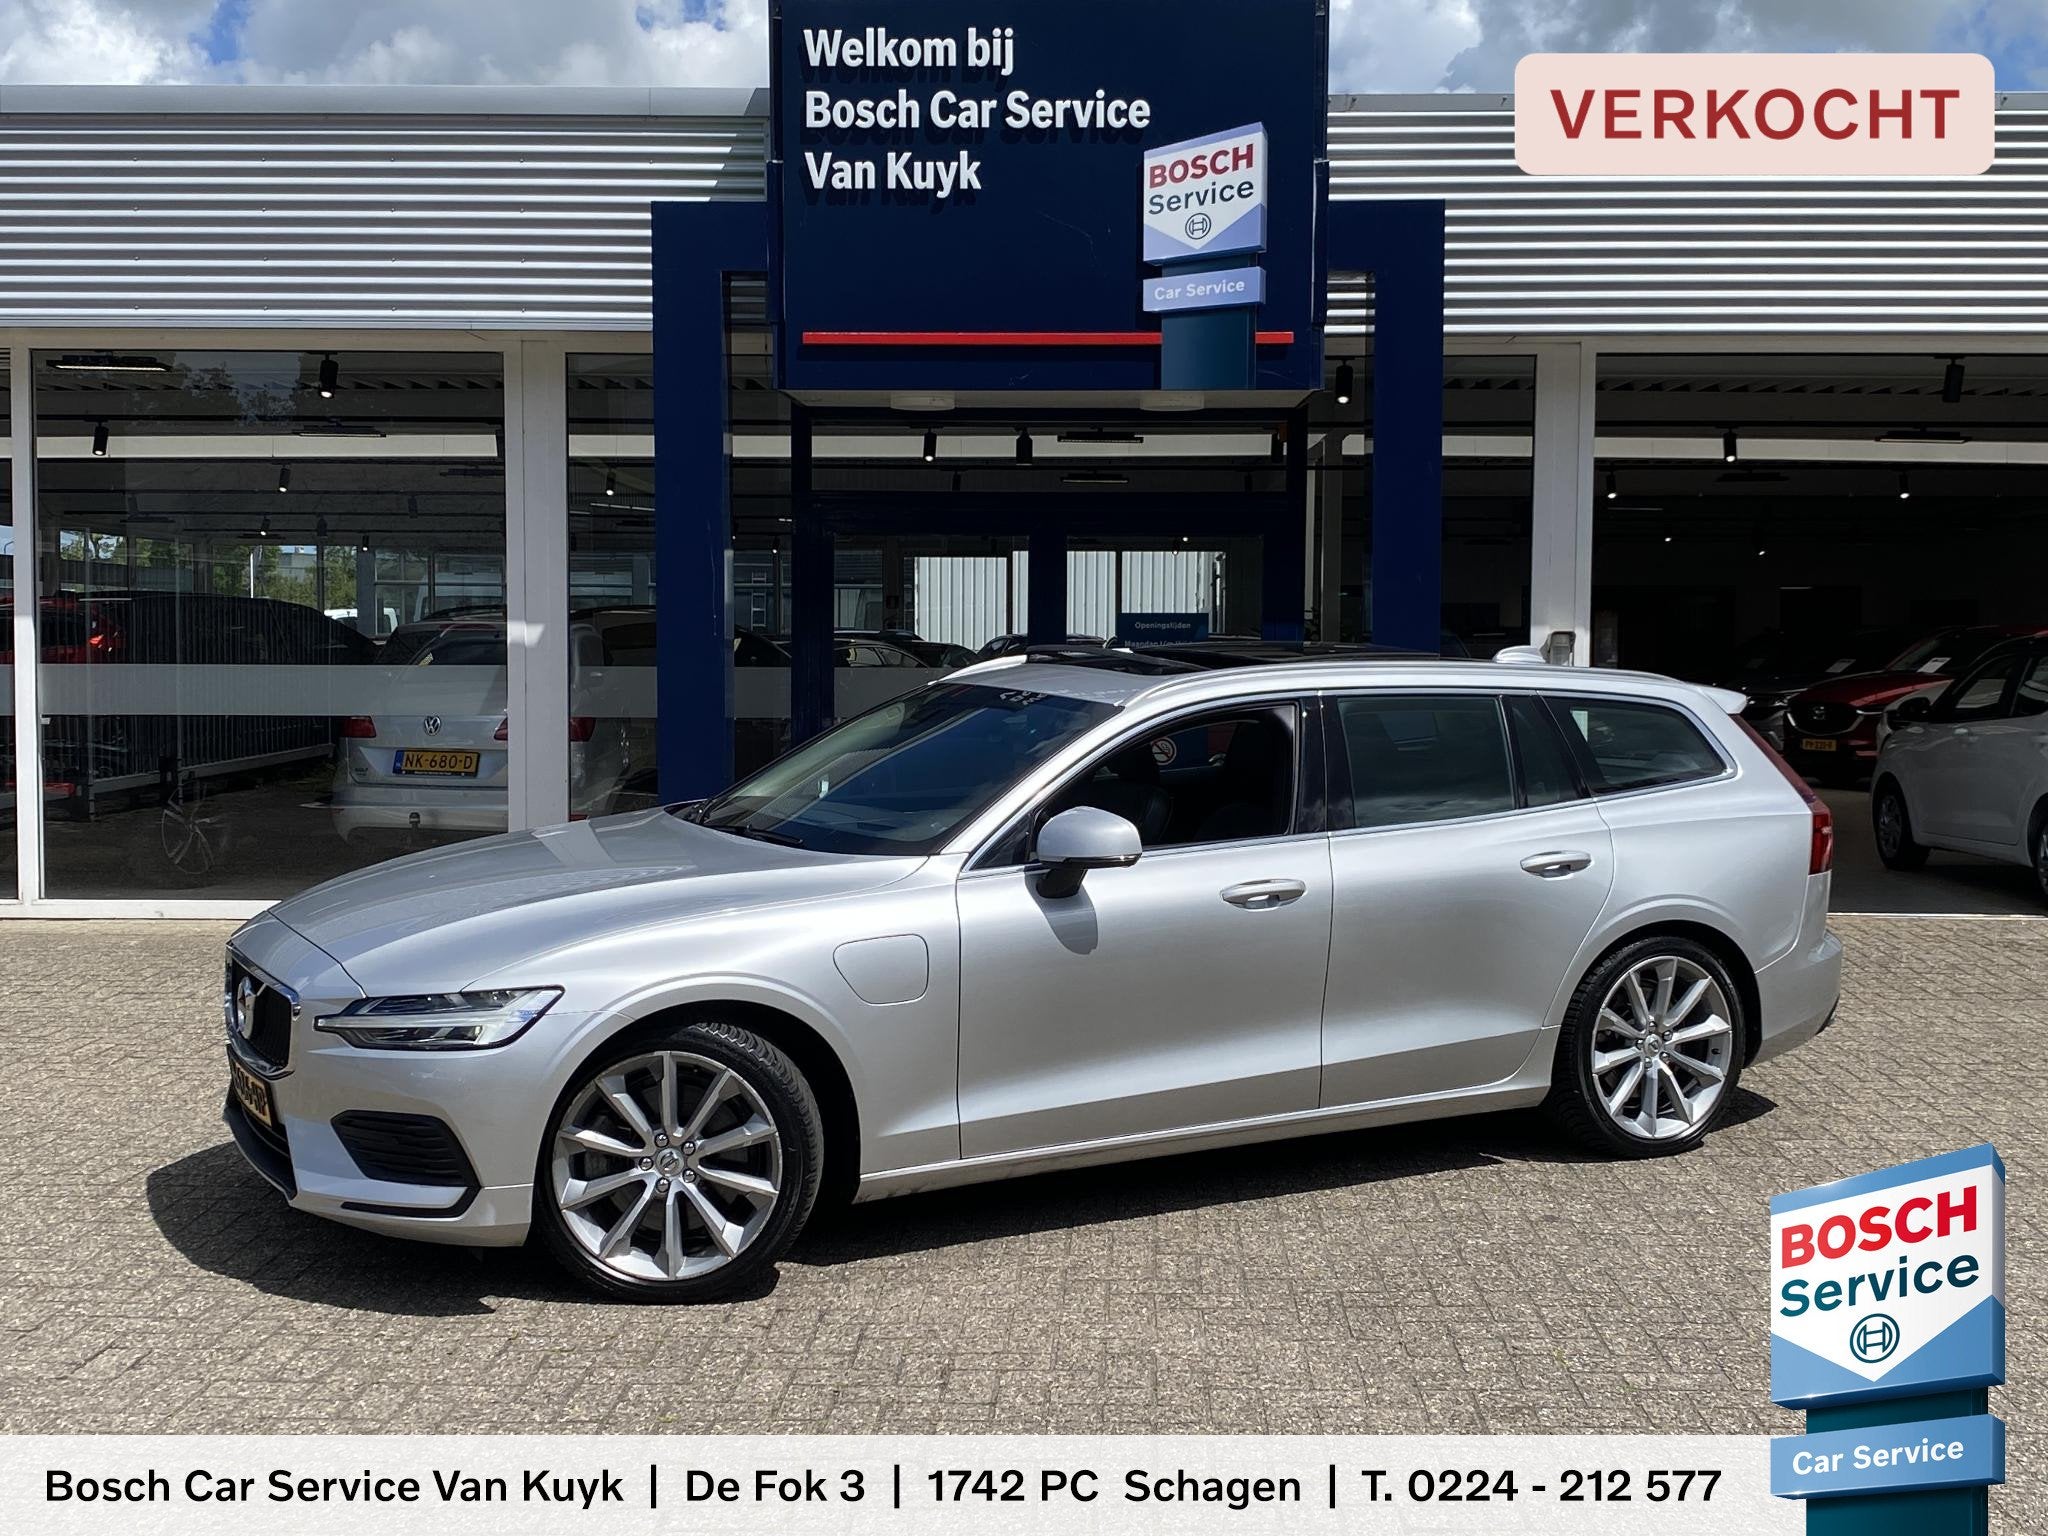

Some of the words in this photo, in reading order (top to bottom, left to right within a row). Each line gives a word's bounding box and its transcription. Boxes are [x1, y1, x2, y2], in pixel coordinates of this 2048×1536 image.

[804, 28, 956, 67] Welkom
[968, 28, 1014, 75] bij
[805, 89, 919, 128] Bosch
[930, 91, 996, 128] Car
[1006, 89, 1150, 128] Service
[805, 152, 875, 189] Van
[888, 151, 981, 198] Kuyk
[1149, 143, 1253, 188] BOSCH
[1148, 180, 1254, 215] Service
[1154, 286, 1182, 300] Car
[1186, 279, 1245, 297] Service
[404, 754, 473, 770] NK-680-D
